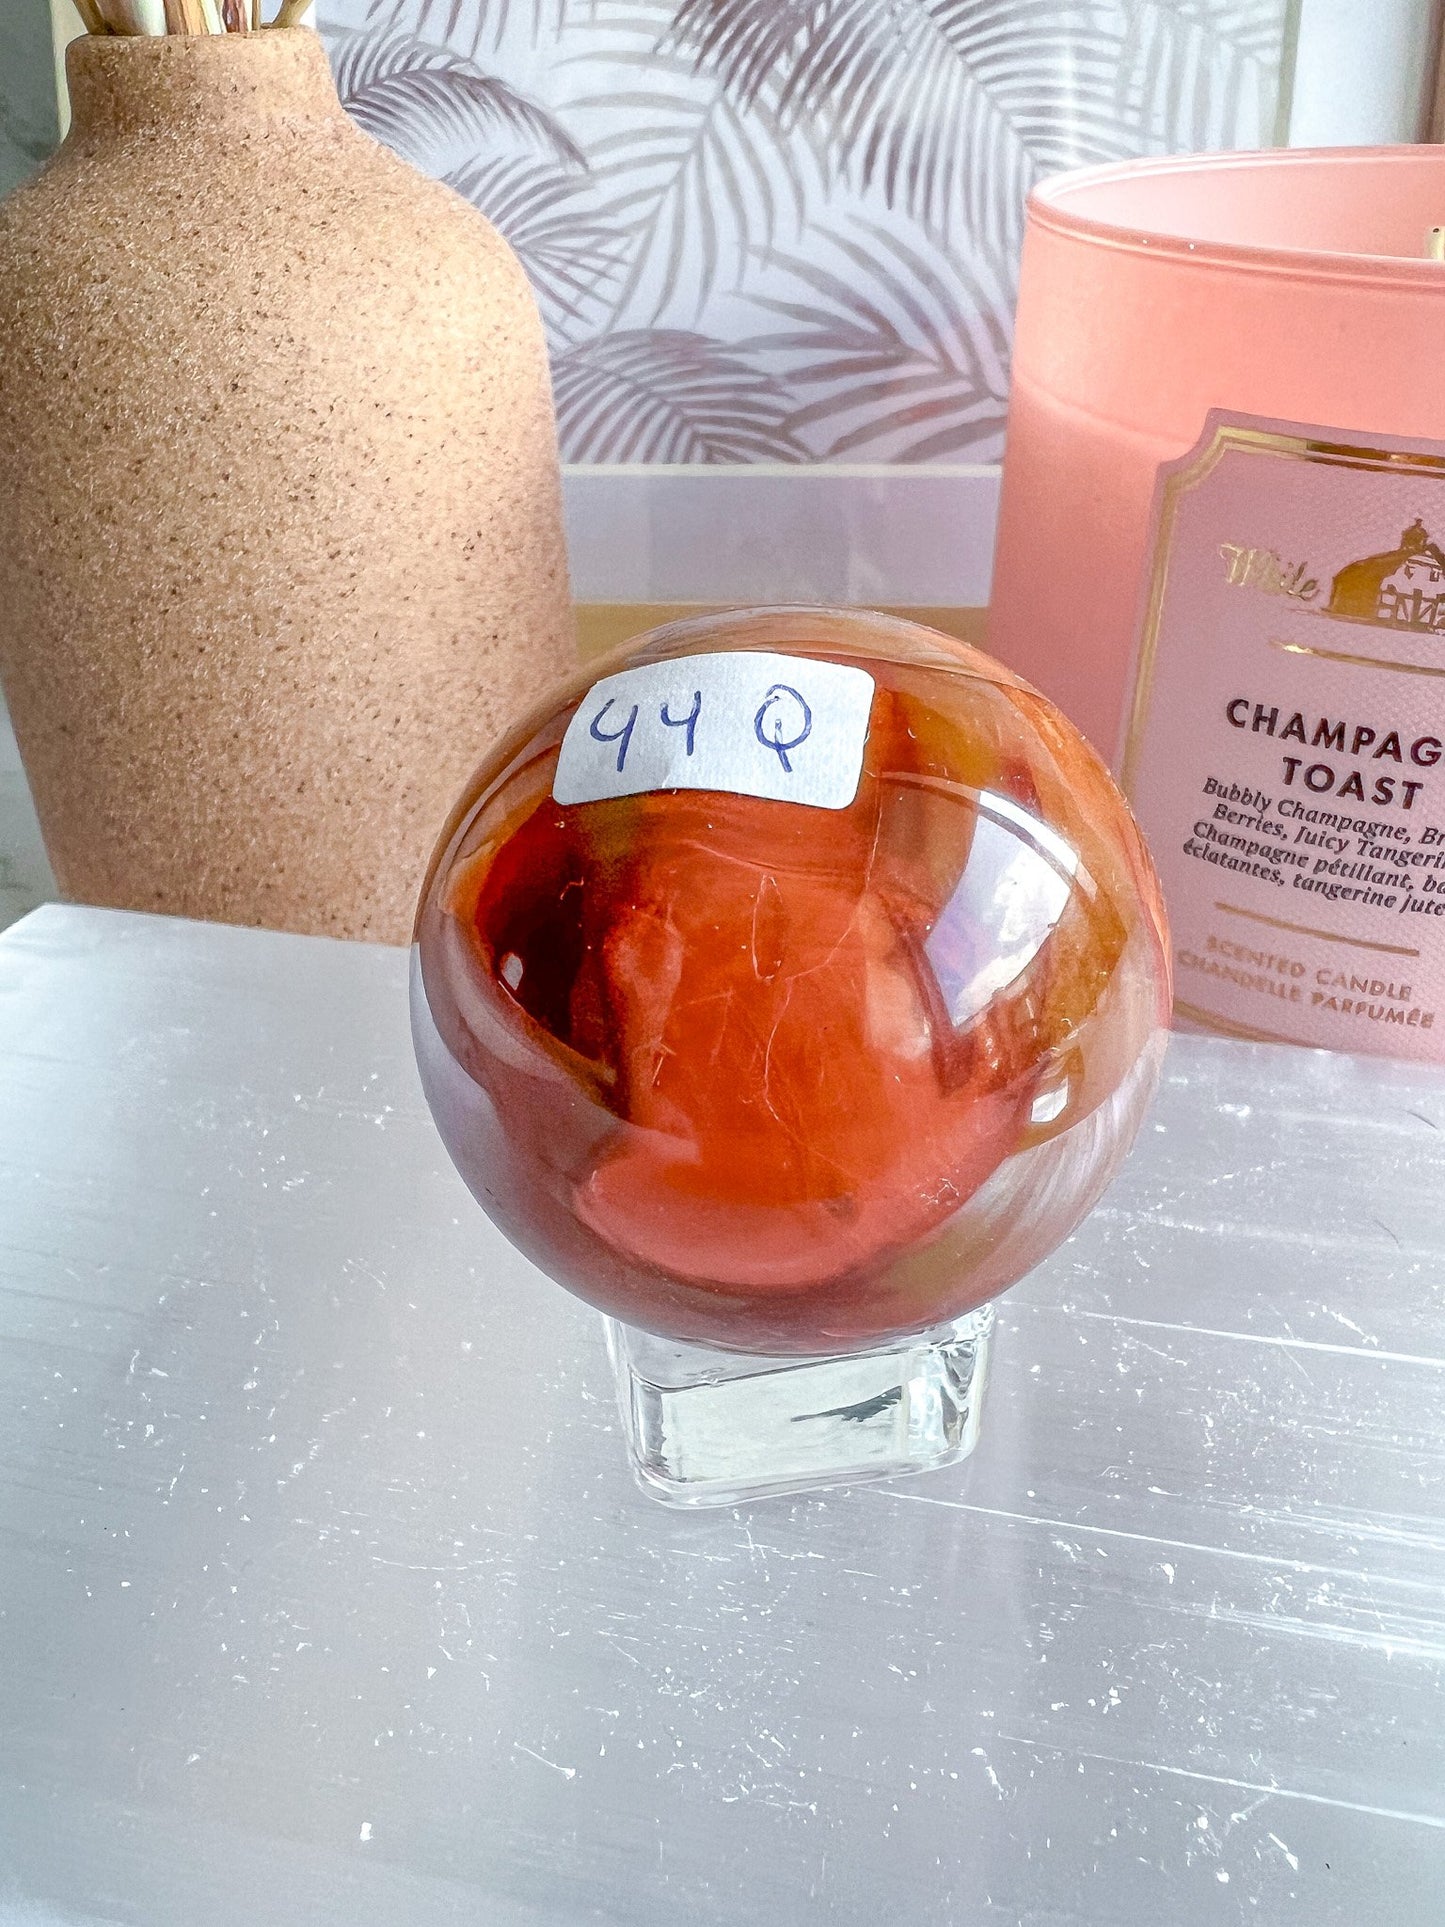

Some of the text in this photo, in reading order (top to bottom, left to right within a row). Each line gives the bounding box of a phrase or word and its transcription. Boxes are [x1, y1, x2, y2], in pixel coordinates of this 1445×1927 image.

[590, 684, 811, 773] 44 Q
[1226, 698, 1443, 767] CHAMPAG
[1202, 777, 1272, 813] Bubbly
[1277, 799, 1411, 845] Champagne,
[1282, 756, 1424, 810] TOAST
[1193, 821, 1309, 868] Champagne
[1212, 803, 1445, 869] Berries, Juicy Tangeri
[1293, 873, 1397, 908] tangerine
[1206, 936, 1411, 1001] SCENTED CANDLE
